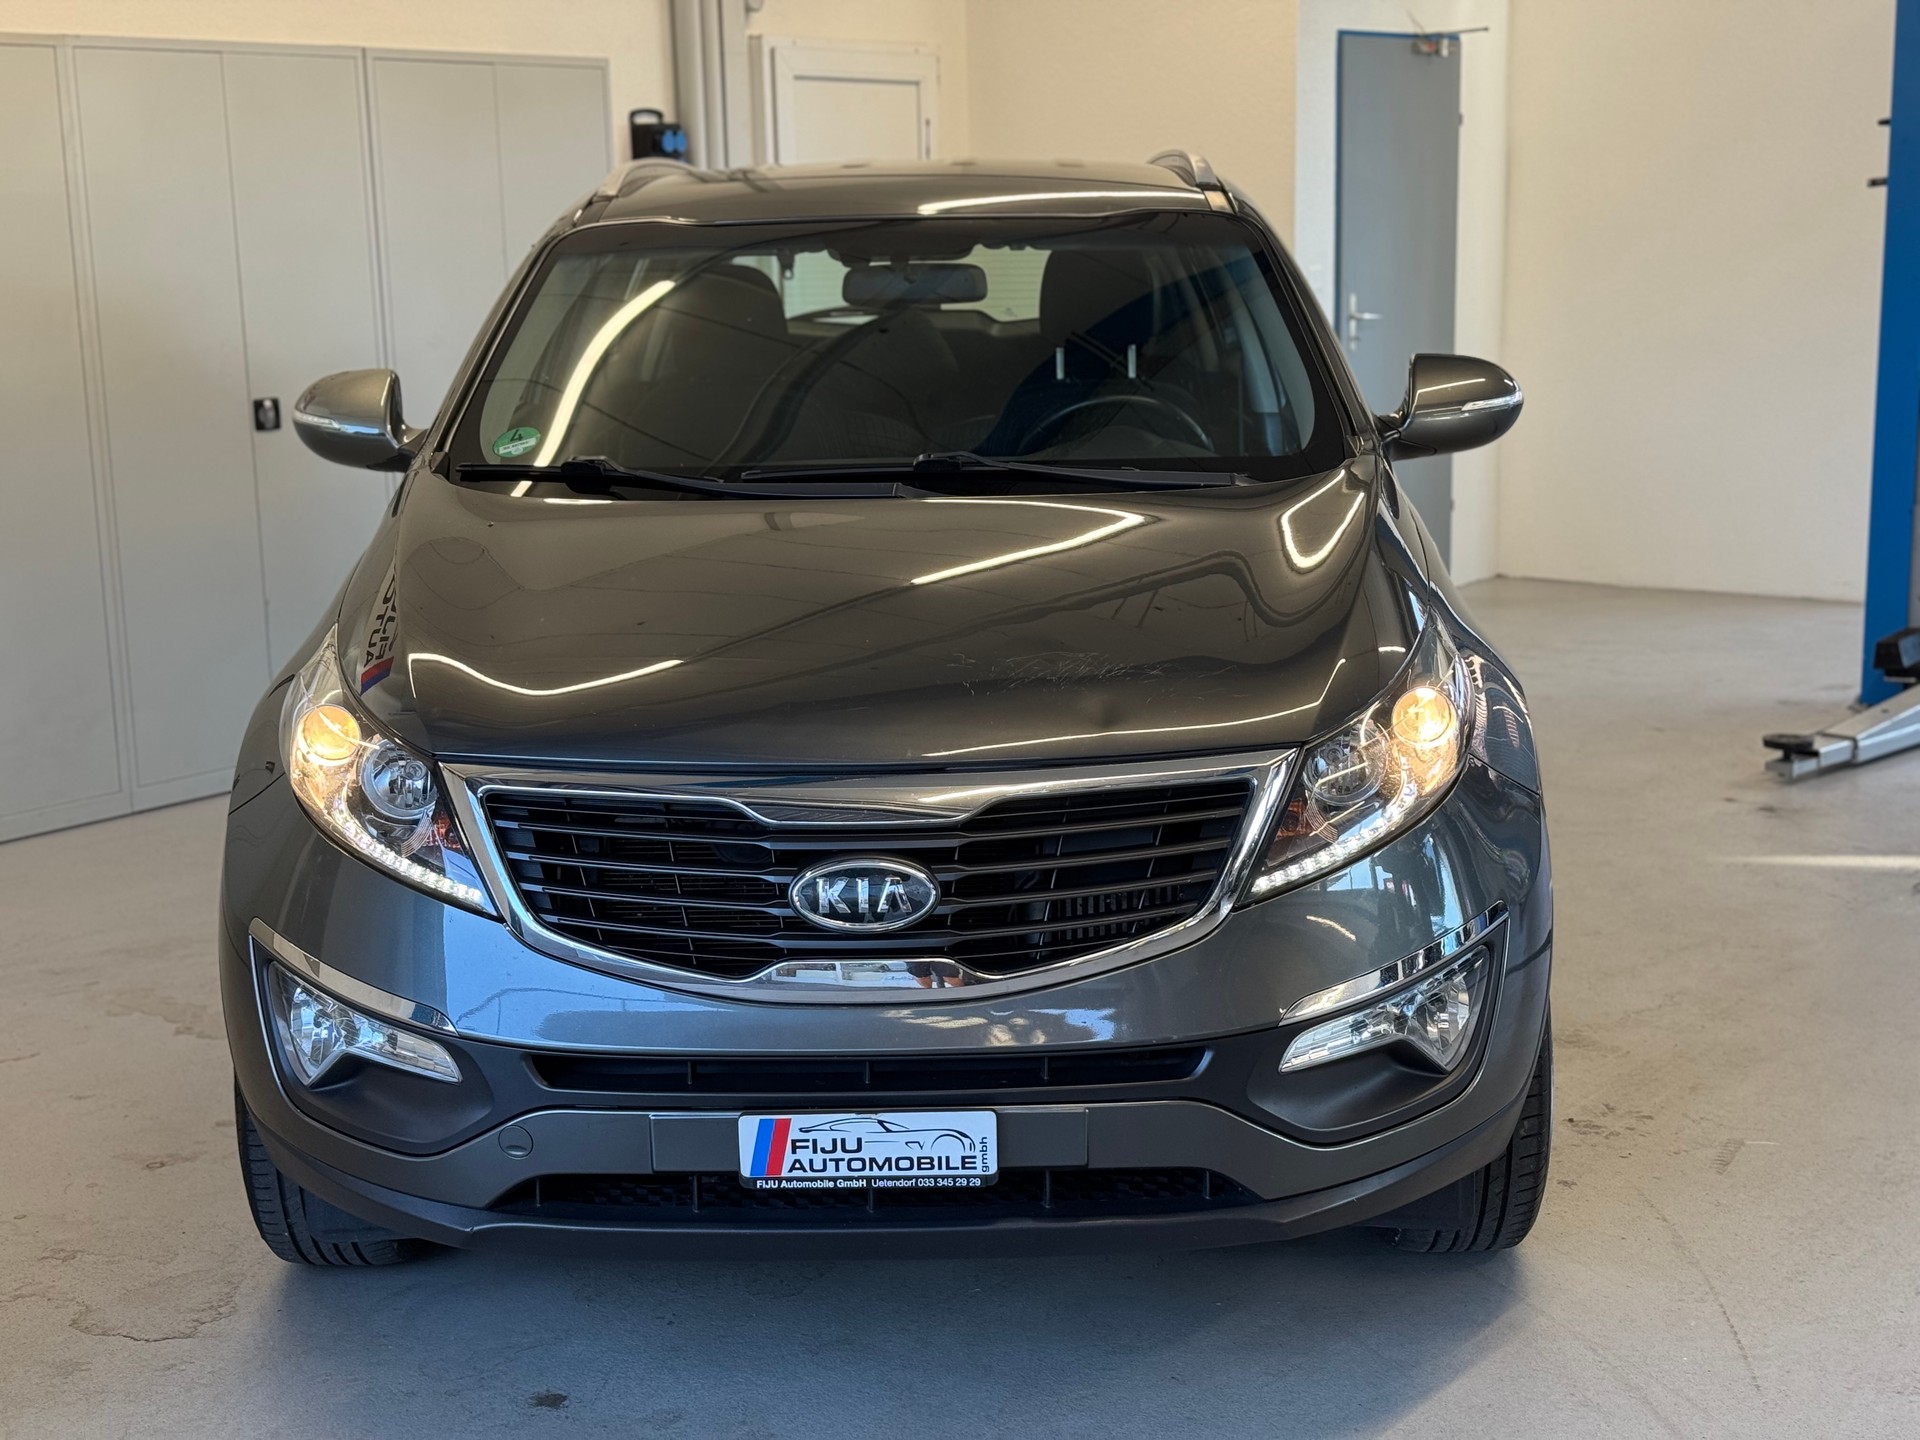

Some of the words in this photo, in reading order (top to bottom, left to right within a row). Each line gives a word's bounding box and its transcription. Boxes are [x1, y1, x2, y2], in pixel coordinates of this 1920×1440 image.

[509, 429, 523, 442] 4
[815, 875, 913, 914] KIA
[790, 1137, 863, 1155] FIJU
[979, 1136, 989, 1173] gmbh
[787, 1155, 978, 1174] AUTOMOBILE
[756, 1179, 779, 1189] FIJU
[780, 1179, 835, 1189] Automobile
[836, 1178, 867, 1188] GmbH
[871, 1178, 916, 1187] Uetendorf
[917, 1178, 935, 1187] 033
[936, 1178, 954, 1187] 345
[955, 1178, 967, 1187] 29
[968, 1177, 981, 1187] 29
